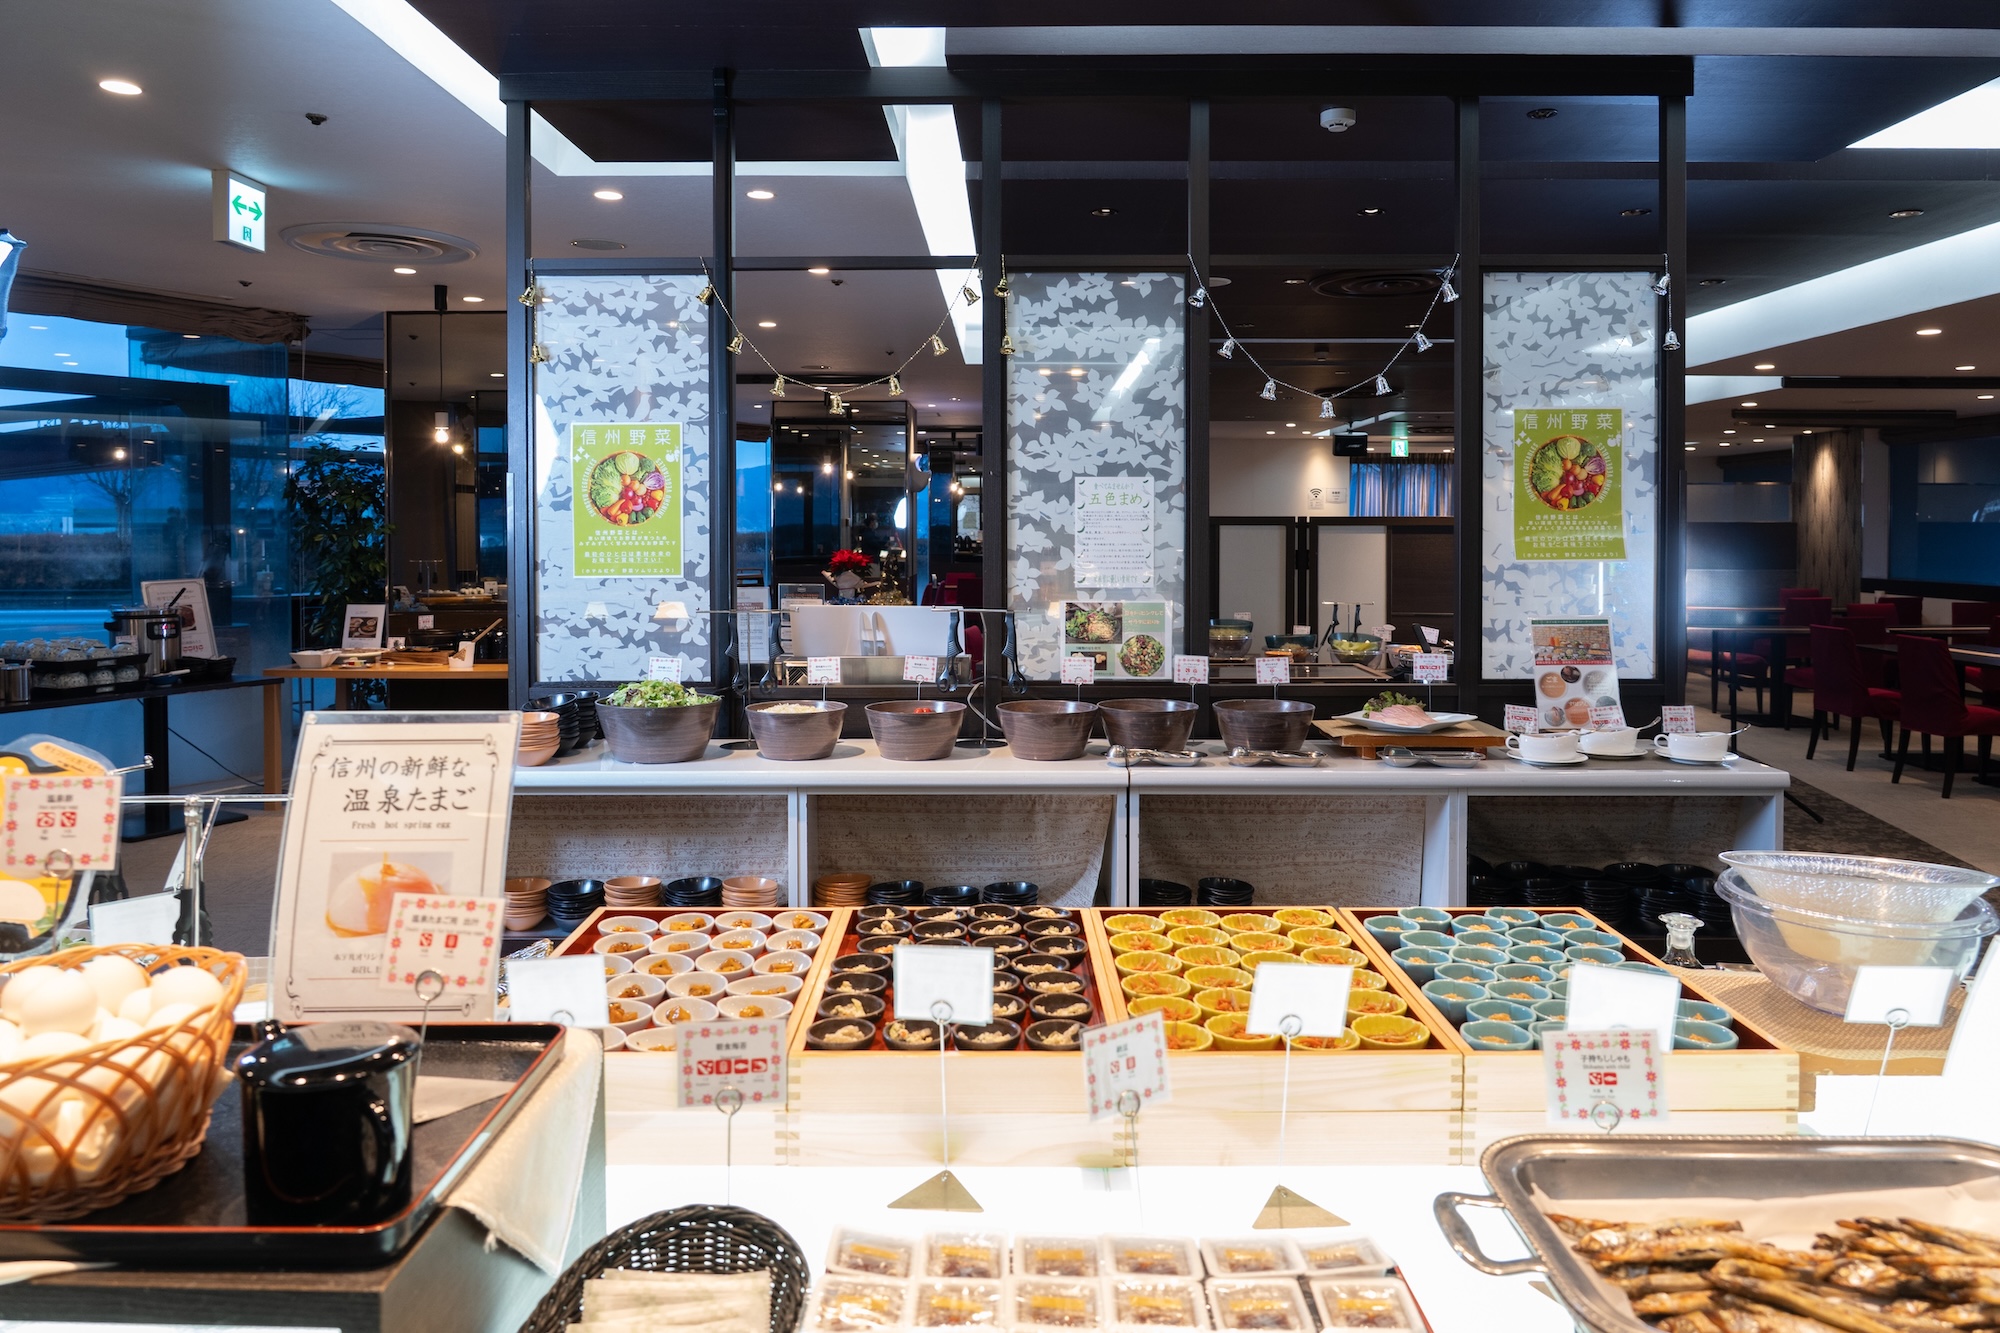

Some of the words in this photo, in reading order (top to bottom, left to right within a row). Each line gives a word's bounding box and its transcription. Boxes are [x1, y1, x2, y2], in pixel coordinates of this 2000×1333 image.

[1522, 413, 1613, 430] 信州野菜
[580, 429, 671, 446] 信州野菜
[1523, 442, 1538, 476] VEGETABLES
[1596, 442, 1613, 478] VEGETABLES
[582, 458, 597, 492] VEGETABLES
[656, 458, 672, 492] VEGETABLES
[1089, 492, 1143, 506] 五色まめ
[328, 756, 470, 779] 信州の新鮮な
[343, 784, 476, 814] 温泉たまご
[352, 821, 376, 829] Fresh
[404, 821, 432, 831] spring
[1581, 1055, 1631, 1063] 子持ちししゃも
